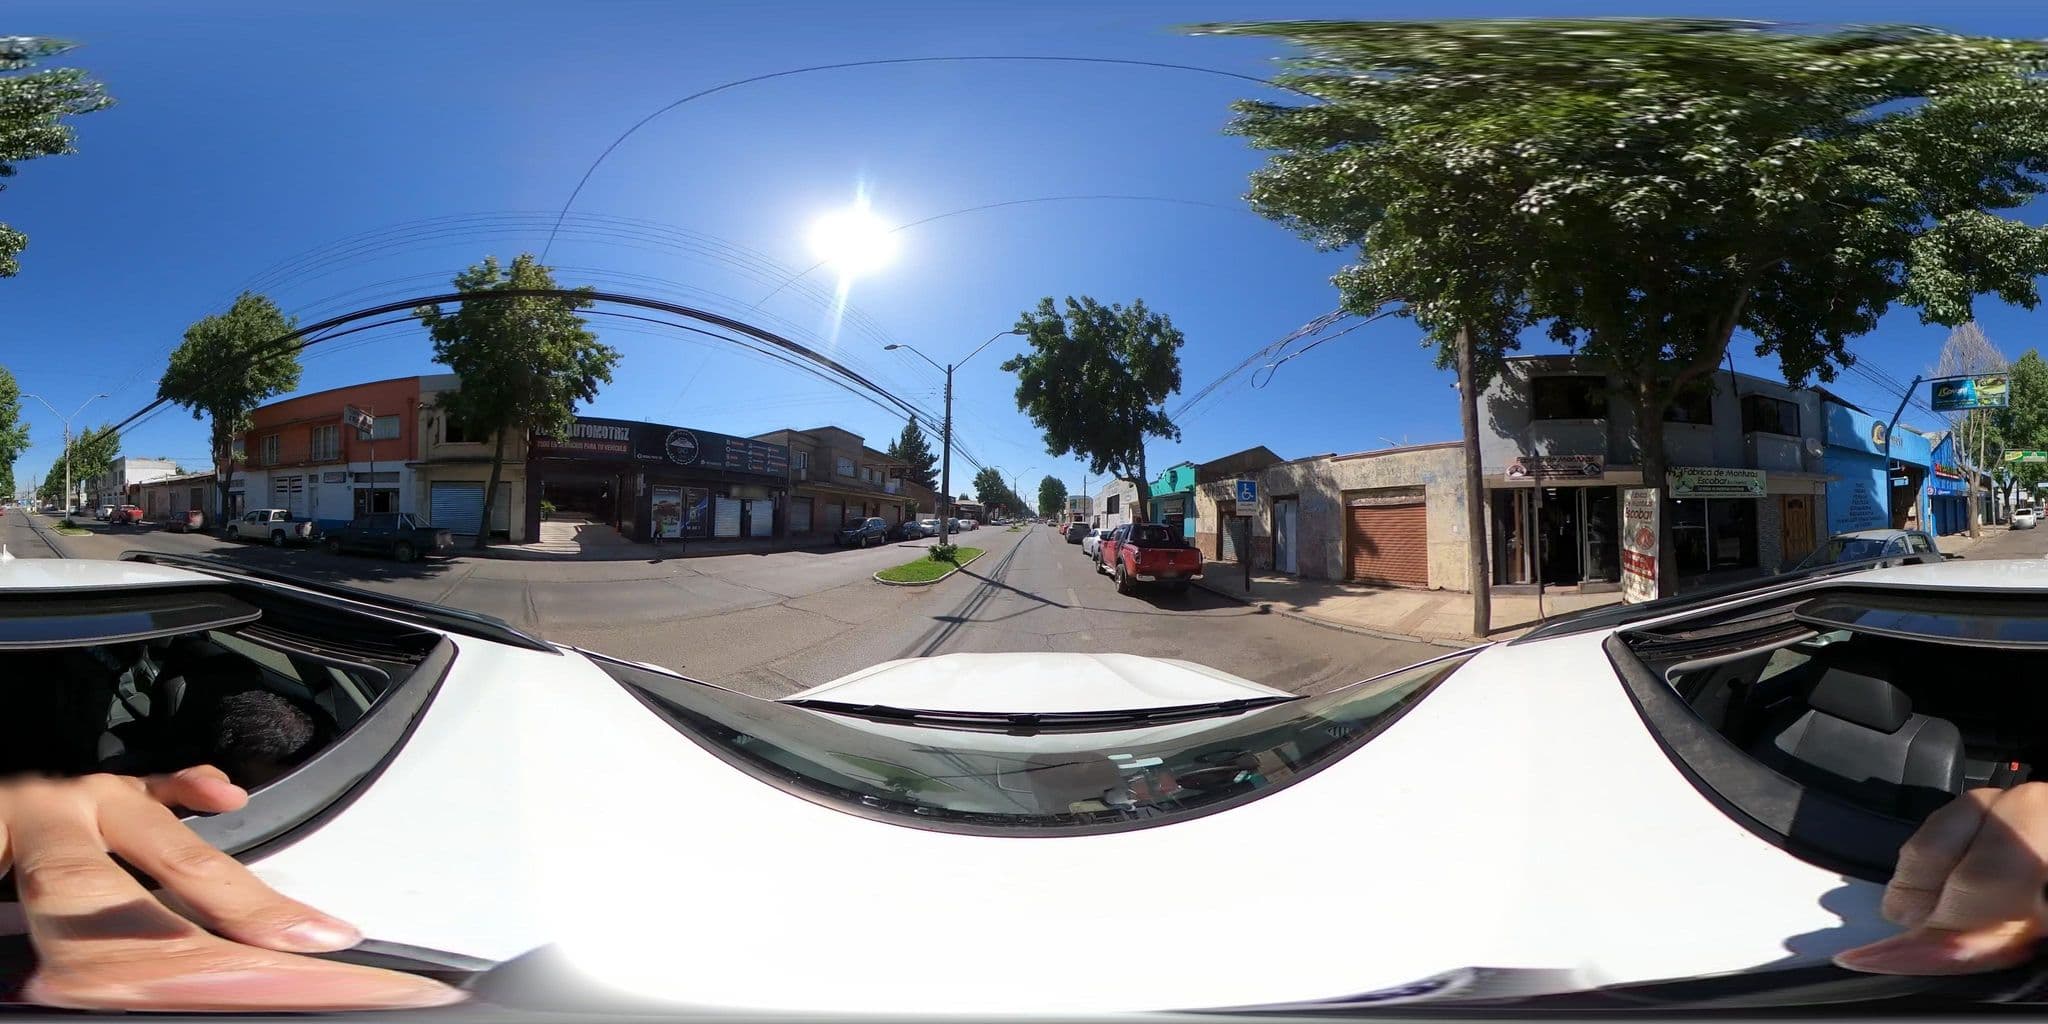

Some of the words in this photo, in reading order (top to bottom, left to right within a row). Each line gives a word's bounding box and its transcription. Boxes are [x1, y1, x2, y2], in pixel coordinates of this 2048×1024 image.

[583, 442, 597, 450] PARA
[597, 443, 605, 451] TU
[1713, 469, 1724, 477] de
[1697, 476, 1728, 485] Escobar
